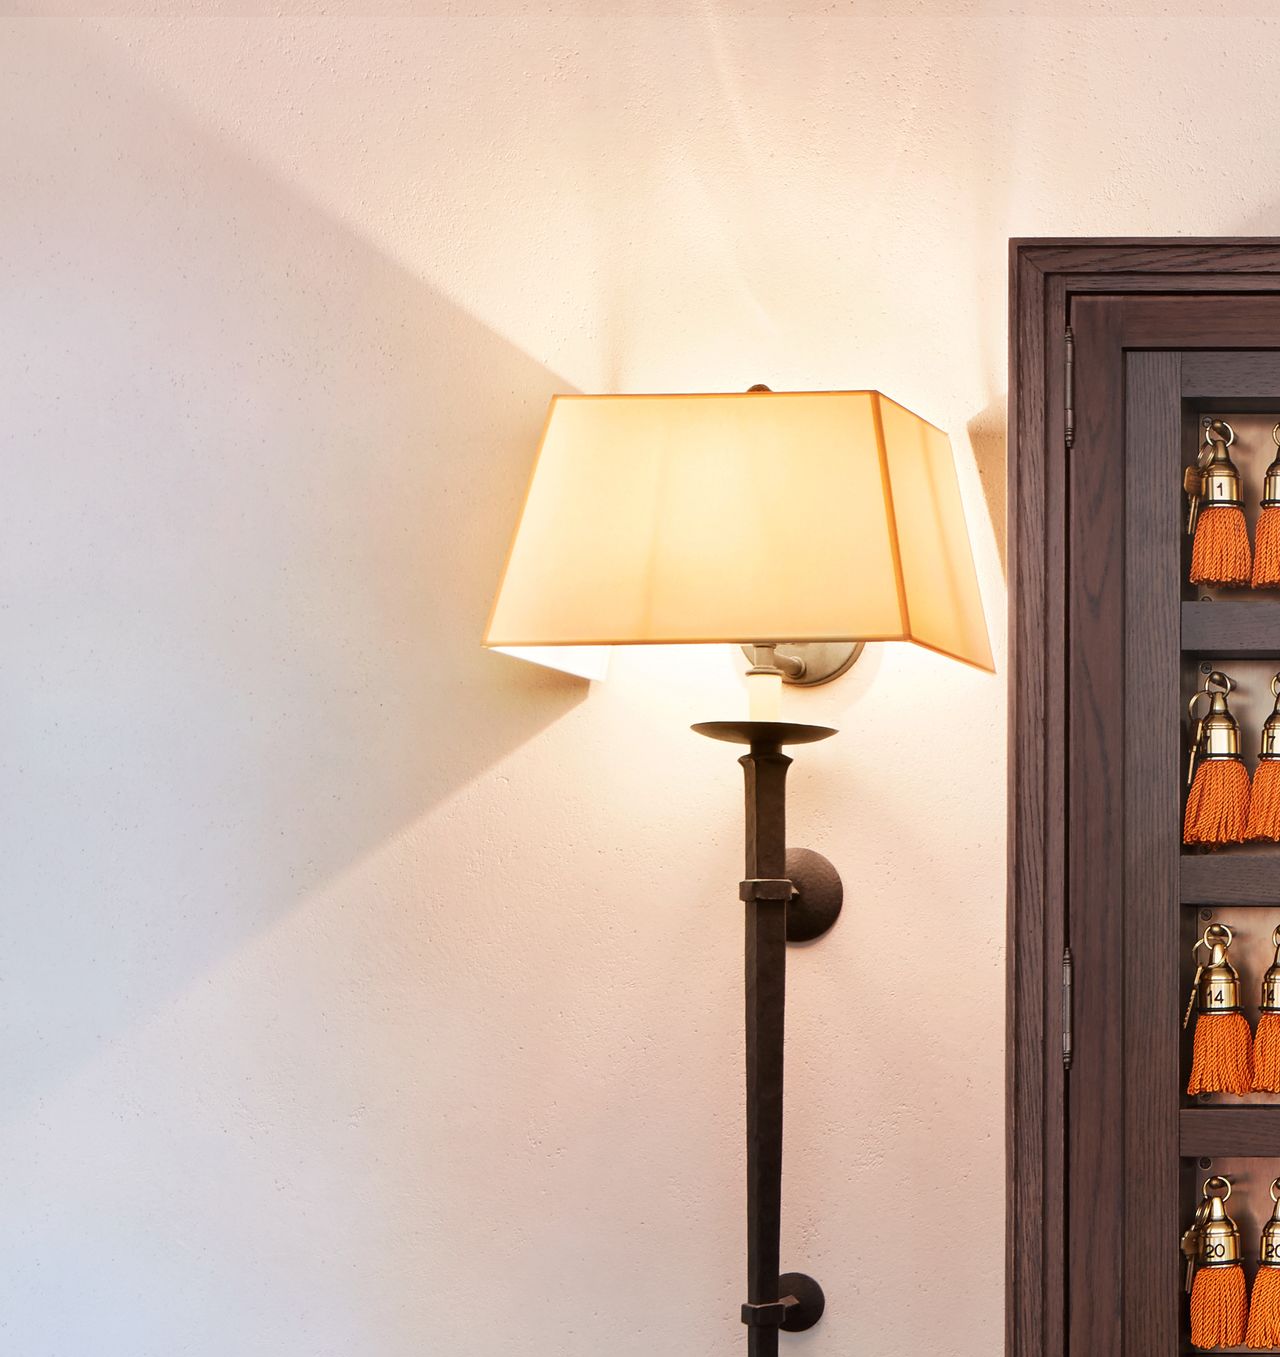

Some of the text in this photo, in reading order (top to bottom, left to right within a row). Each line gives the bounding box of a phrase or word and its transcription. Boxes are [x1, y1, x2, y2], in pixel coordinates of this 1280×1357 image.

[1216, 482, 1223, 496] 1
[1268, 736, 1275, 750] 7
[1207, 990, 1224, 1004] 14
[1263, 989, 1275, 1003] 14
[1205, 1244, 1225, 1258] 20
